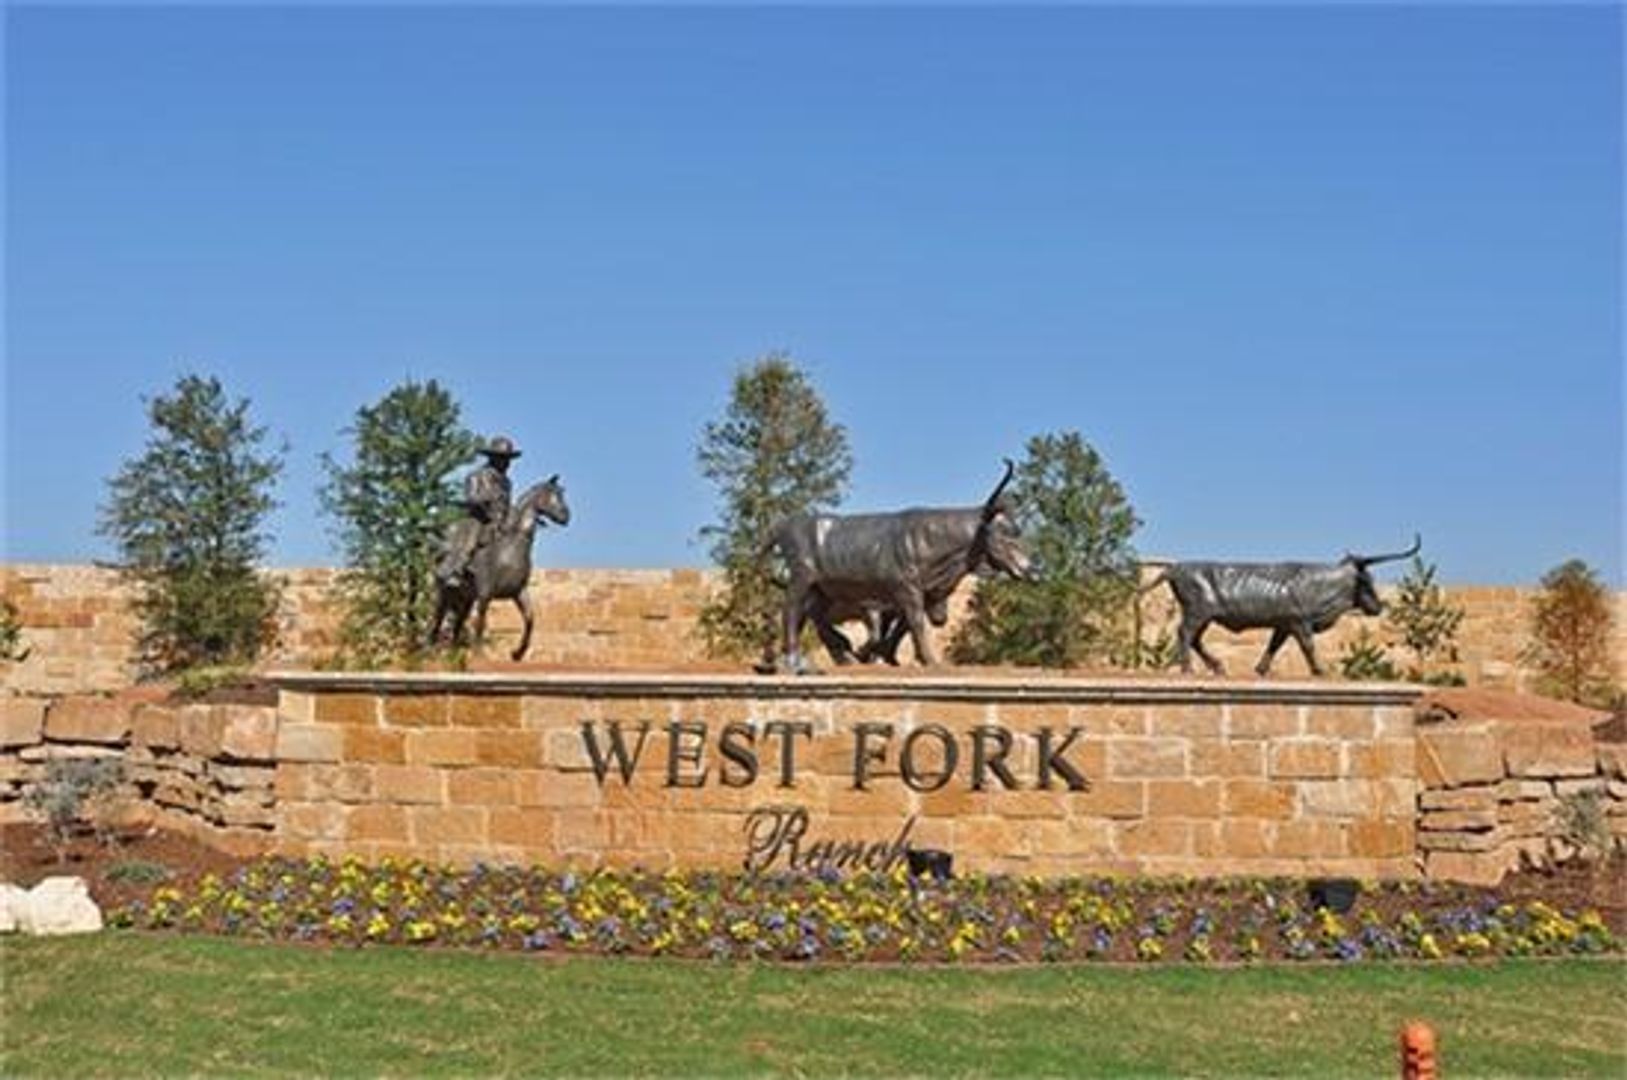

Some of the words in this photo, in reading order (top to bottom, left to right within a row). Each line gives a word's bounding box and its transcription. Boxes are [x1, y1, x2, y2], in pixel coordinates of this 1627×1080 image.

[578, 720, 813, 789] WEST
[850, 724, 1093, 792] FORK
[743, 806, 913, 873] Ranch
